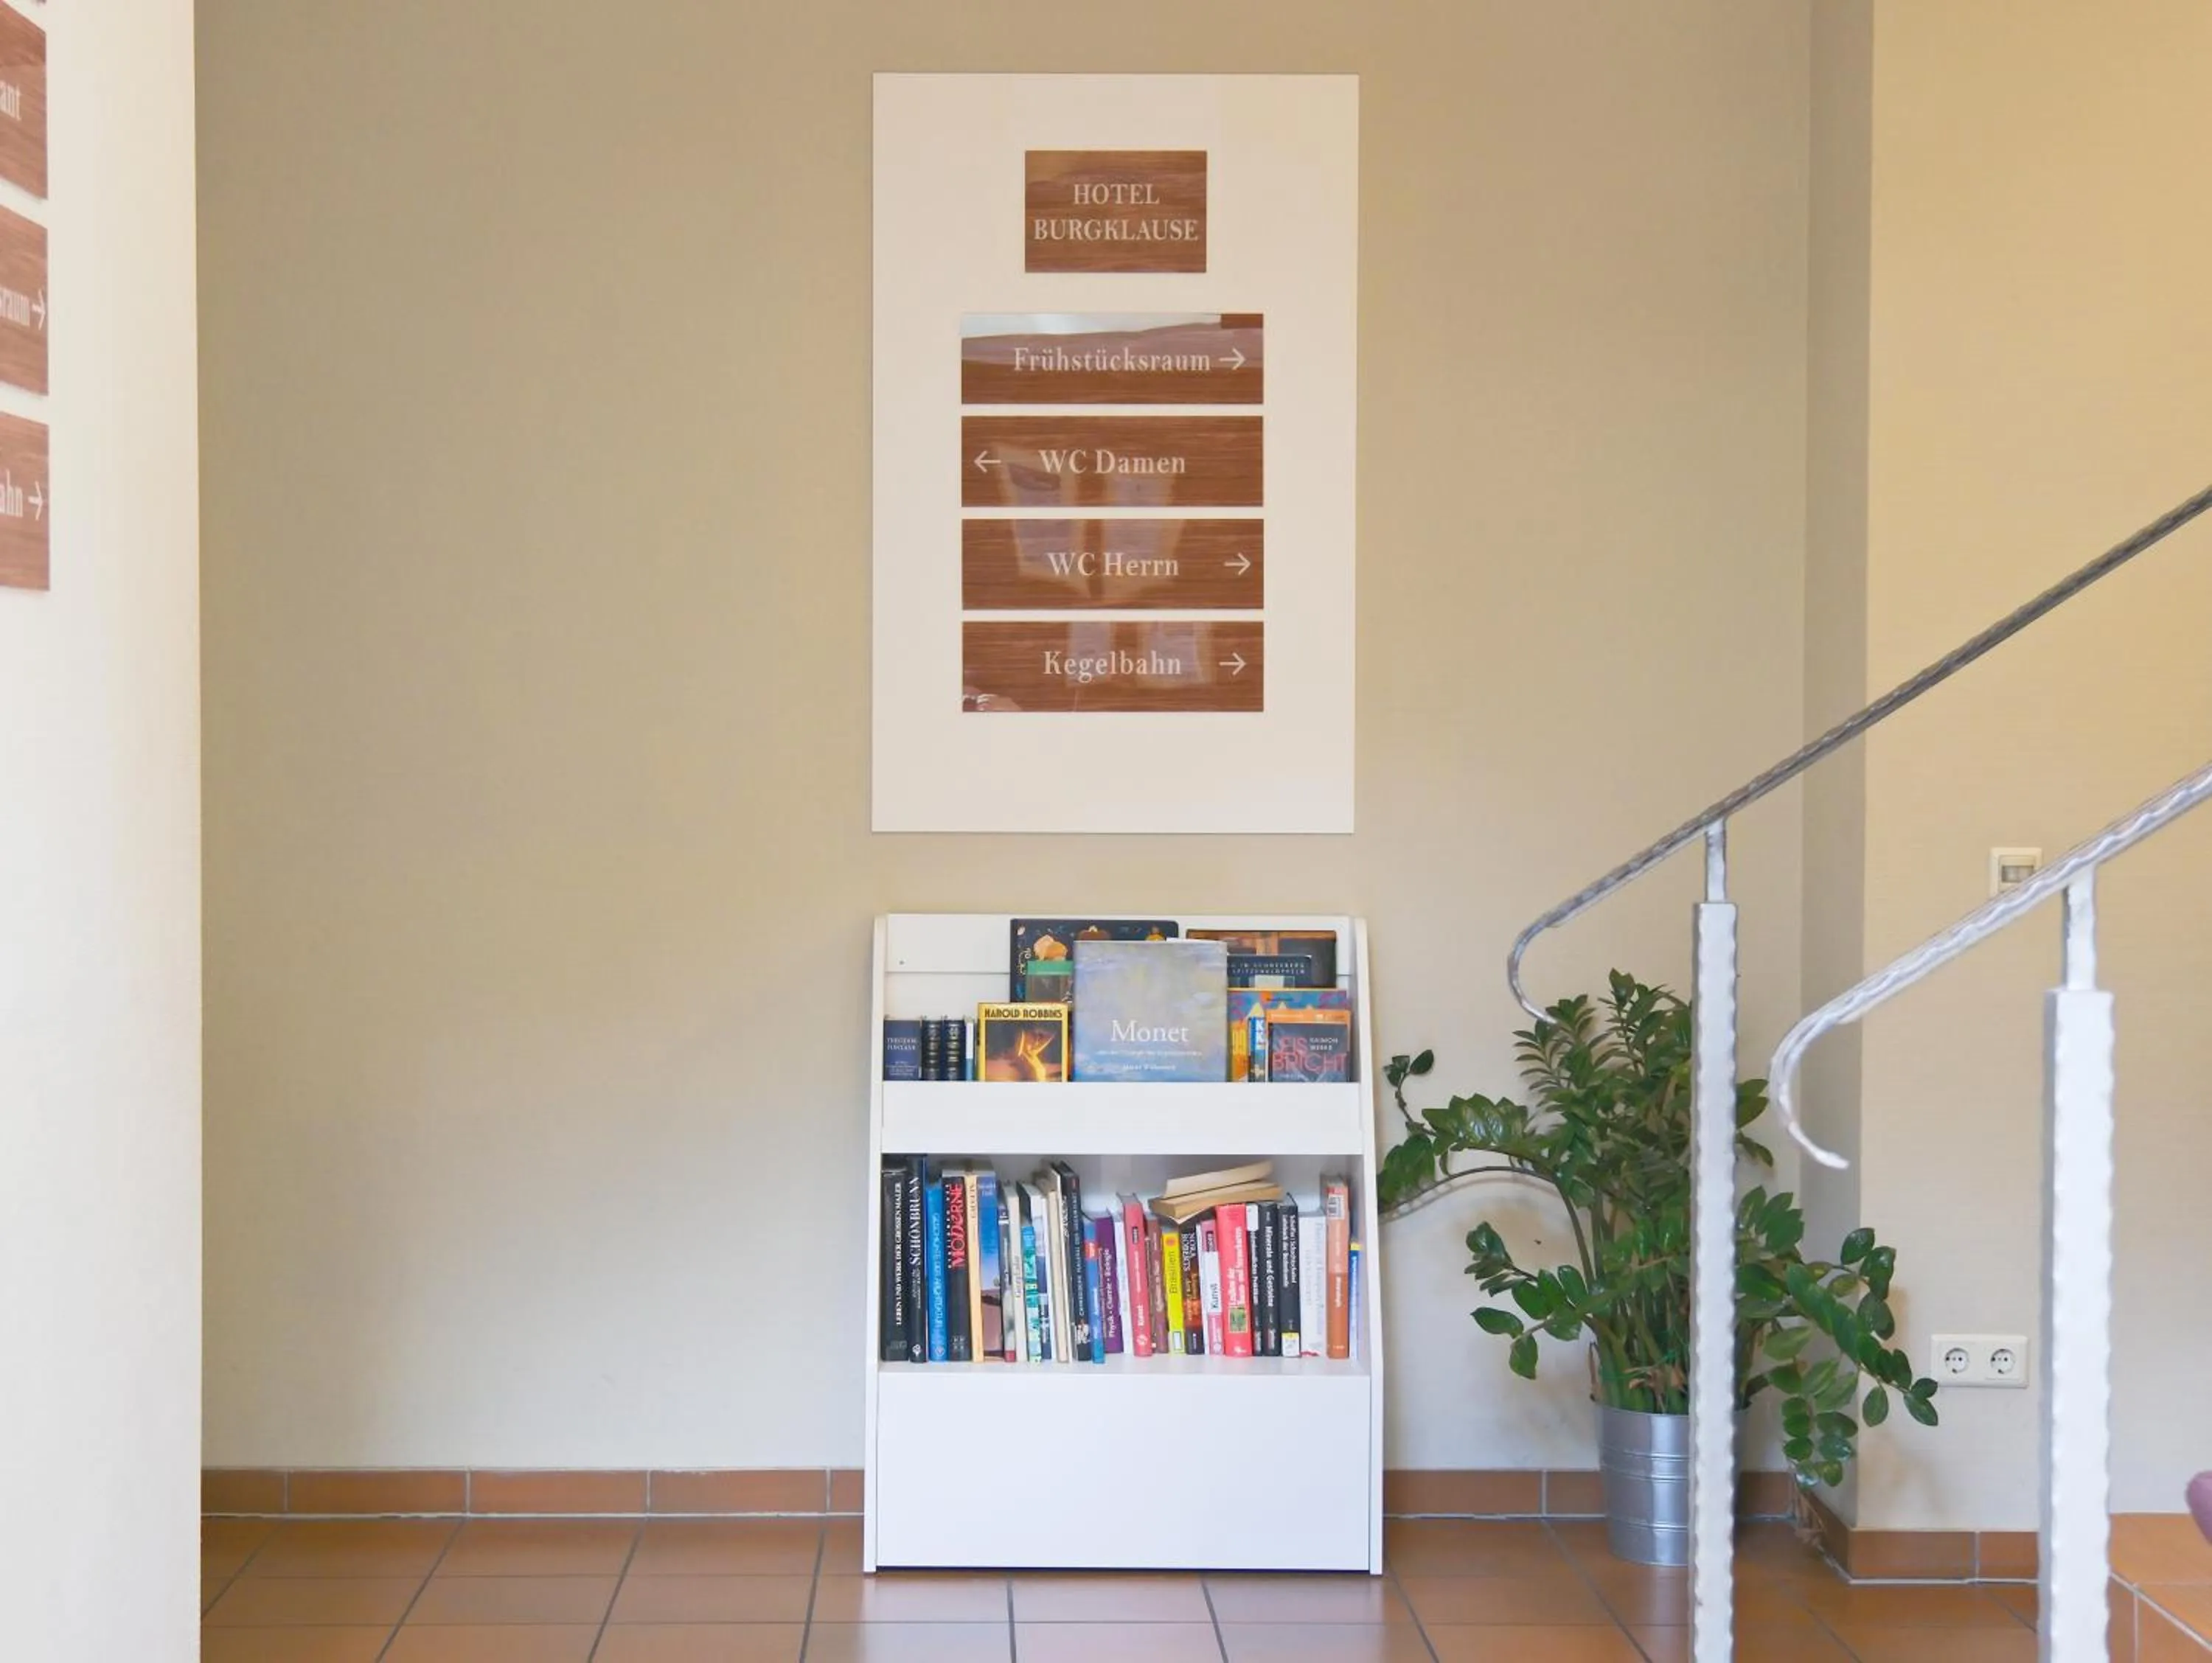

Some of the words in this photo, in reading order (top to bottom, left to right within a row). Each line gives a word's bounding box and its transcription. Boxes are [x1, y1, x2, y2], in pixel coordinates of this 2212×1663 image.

[1074, 184, 1160, 205] HOTEL
[1034, 219, 1198, 241] BURGKLAUSE
[1014, 347, 1211, 371] Frühstücksraum
[1039, 450, 1087, 474] WC
[1096, 450, 1186, 474] Damen
[1047, 552, 1094, 576] WC
[1103, 552, 1180, 576] Herrn
[1043, 650, 1181, 683] Kegelbahn
[984, 1008, 1020, 1019] HAROLD
[1023, 1008, 1063, 1019] ROBBINS
[1110, 1019, 1190, 1042] Monet
[1107, 1315, 1116, 1338] Physik
